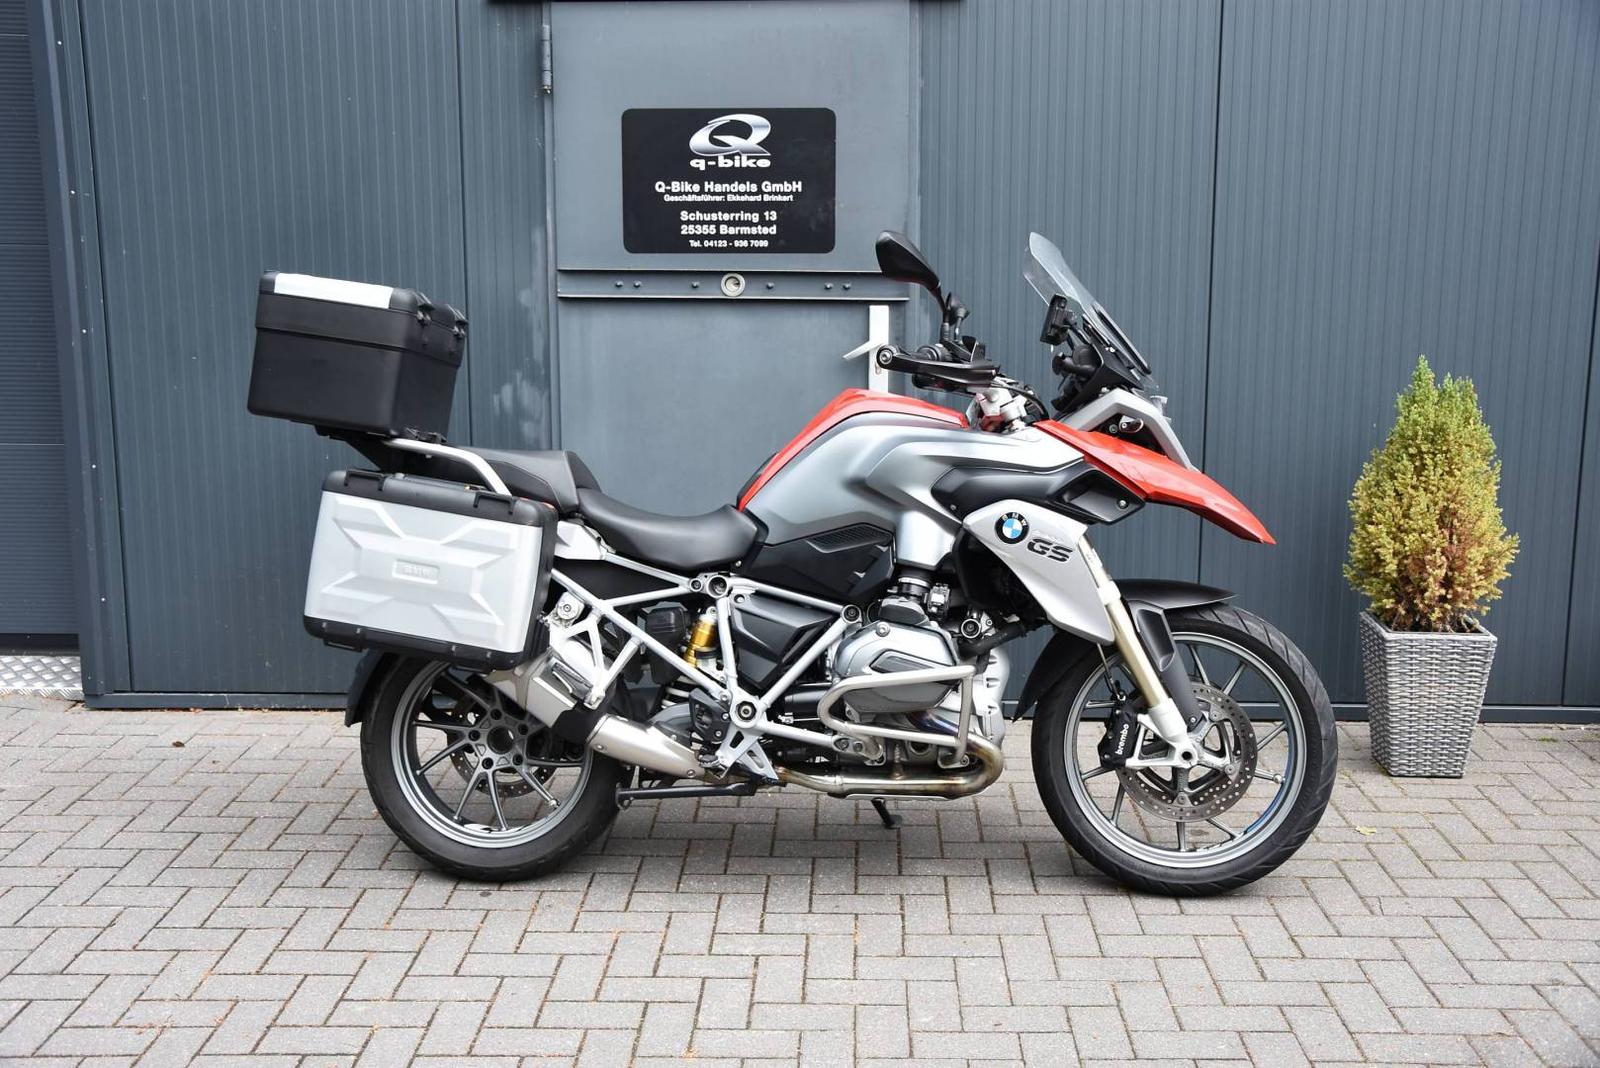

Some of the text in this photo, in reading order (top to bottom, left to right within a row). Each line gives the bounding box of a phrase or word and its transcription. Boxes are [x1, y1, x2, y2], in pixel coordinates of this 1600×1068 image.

[689, 113, 771, 156] Q
[690, 155, 771, 170] q-bike
[655, 181, 802, 193] Q-Bike Handels GmbH
[663, 194, 726, 202] Geschäftsführer:
[726, 194, 762, 202] Ekkehard
[680, 210, 777, 225] Schusterring 13
[680, 224, 777, 235] 25355 Barmsted
[689, 239, 702, 248] Tel.
[703, 239, 728, 248] 04123
[1026, 538, 1073, 563] GS
[1115, 723, 1129, 755] brembo
